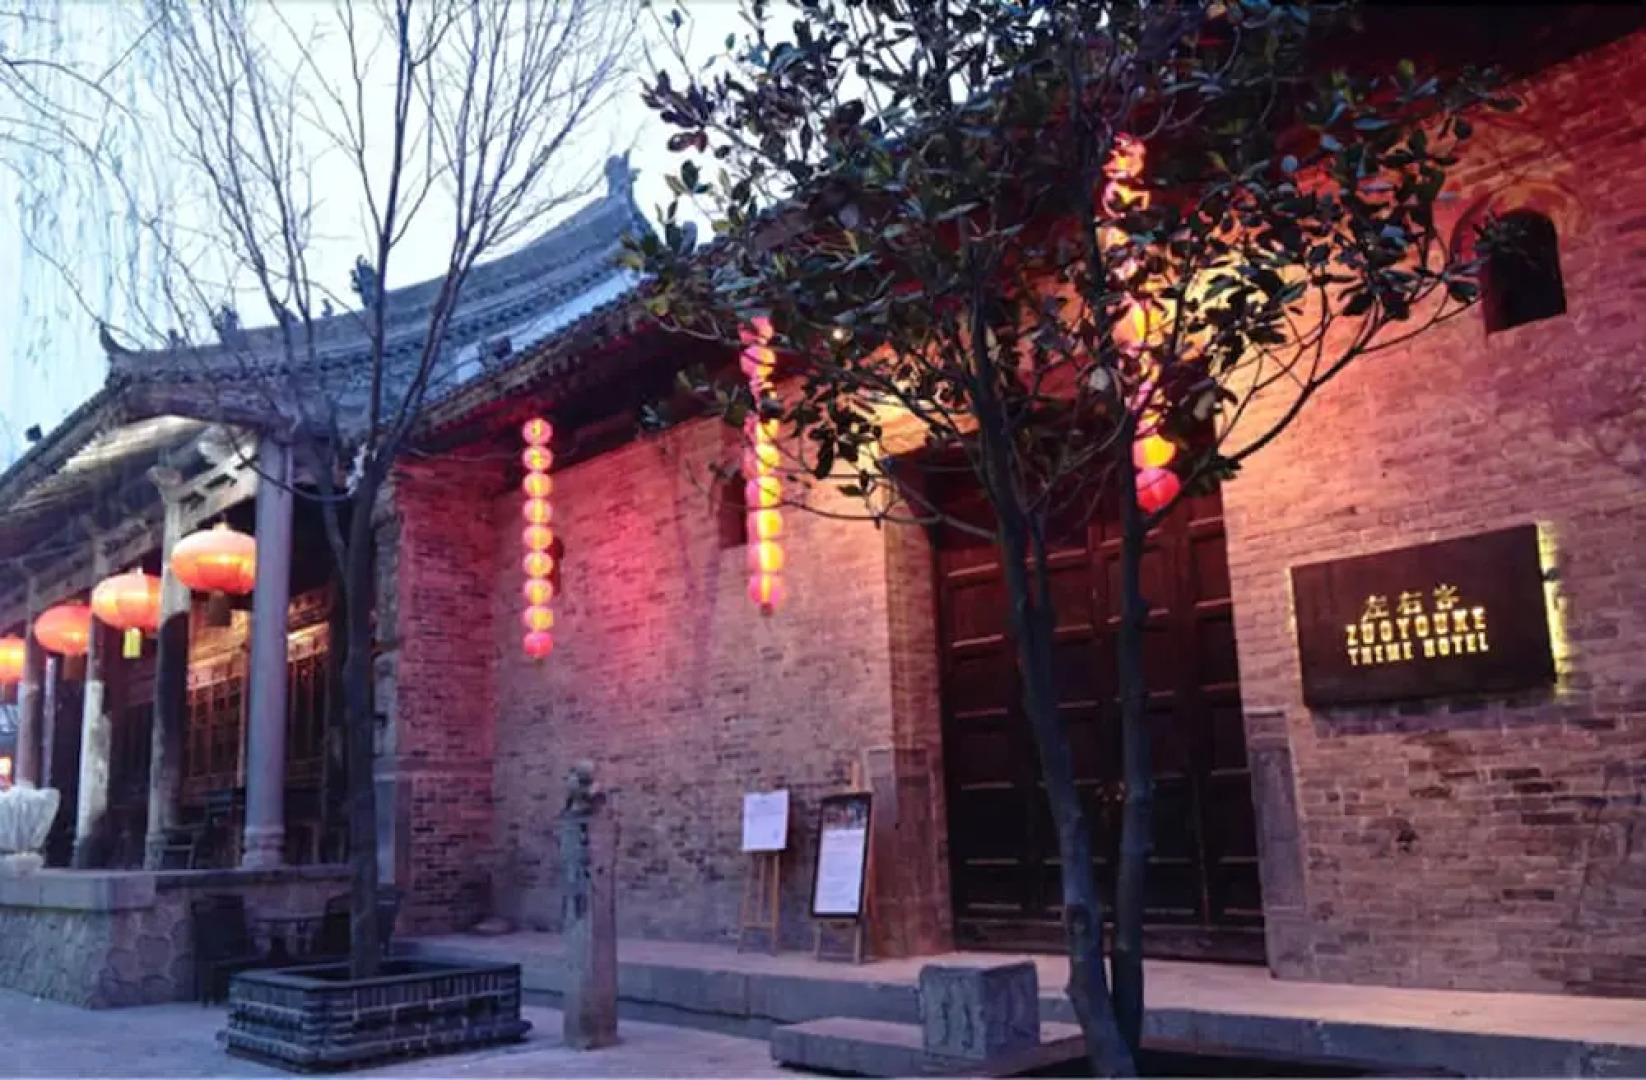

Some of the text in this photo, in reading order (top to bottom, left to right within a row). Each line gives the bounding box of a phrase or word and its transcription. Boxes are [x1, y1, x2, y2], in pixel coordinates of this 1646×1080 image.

[1345, 606, 1486, 646] ZUOYOUKE
[1348, 632, 1488, 666] THEME HOTEL
